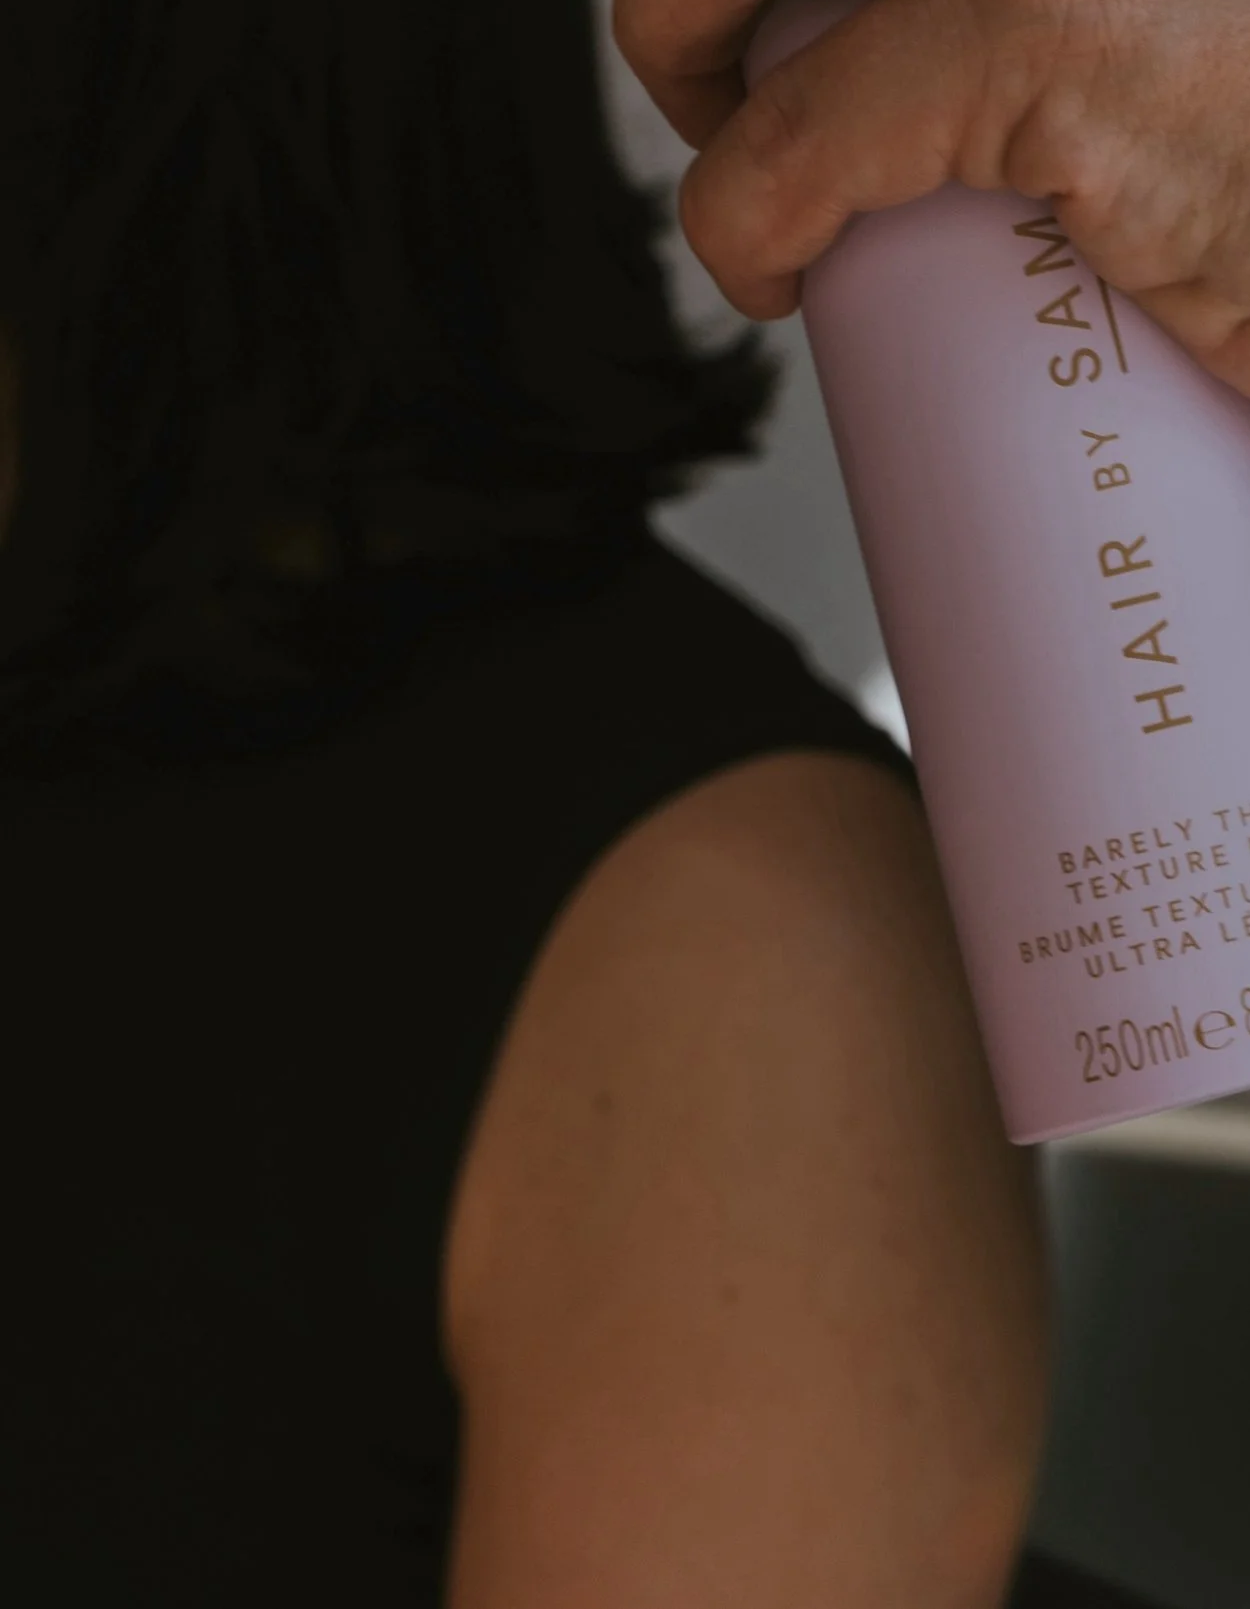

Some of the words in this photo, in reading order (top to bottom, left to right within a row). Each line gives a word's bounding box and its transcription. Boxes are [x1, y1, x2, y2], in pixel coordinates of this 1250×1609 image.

[1012, 215, 1103, 388] SAM
[1080, 428, 1132, 492] BY
[1096, 534, 1195, 735] HAIR
[1058, 819, 1194, 874] BARELY
[1067, 844, 1230, 905] TEXTURE
[1018, 915, 1135, 964] BRUME
[1083, 932, 1202, 979] ULTRA
[1074, 1005, 1190, 1084] 250ml
